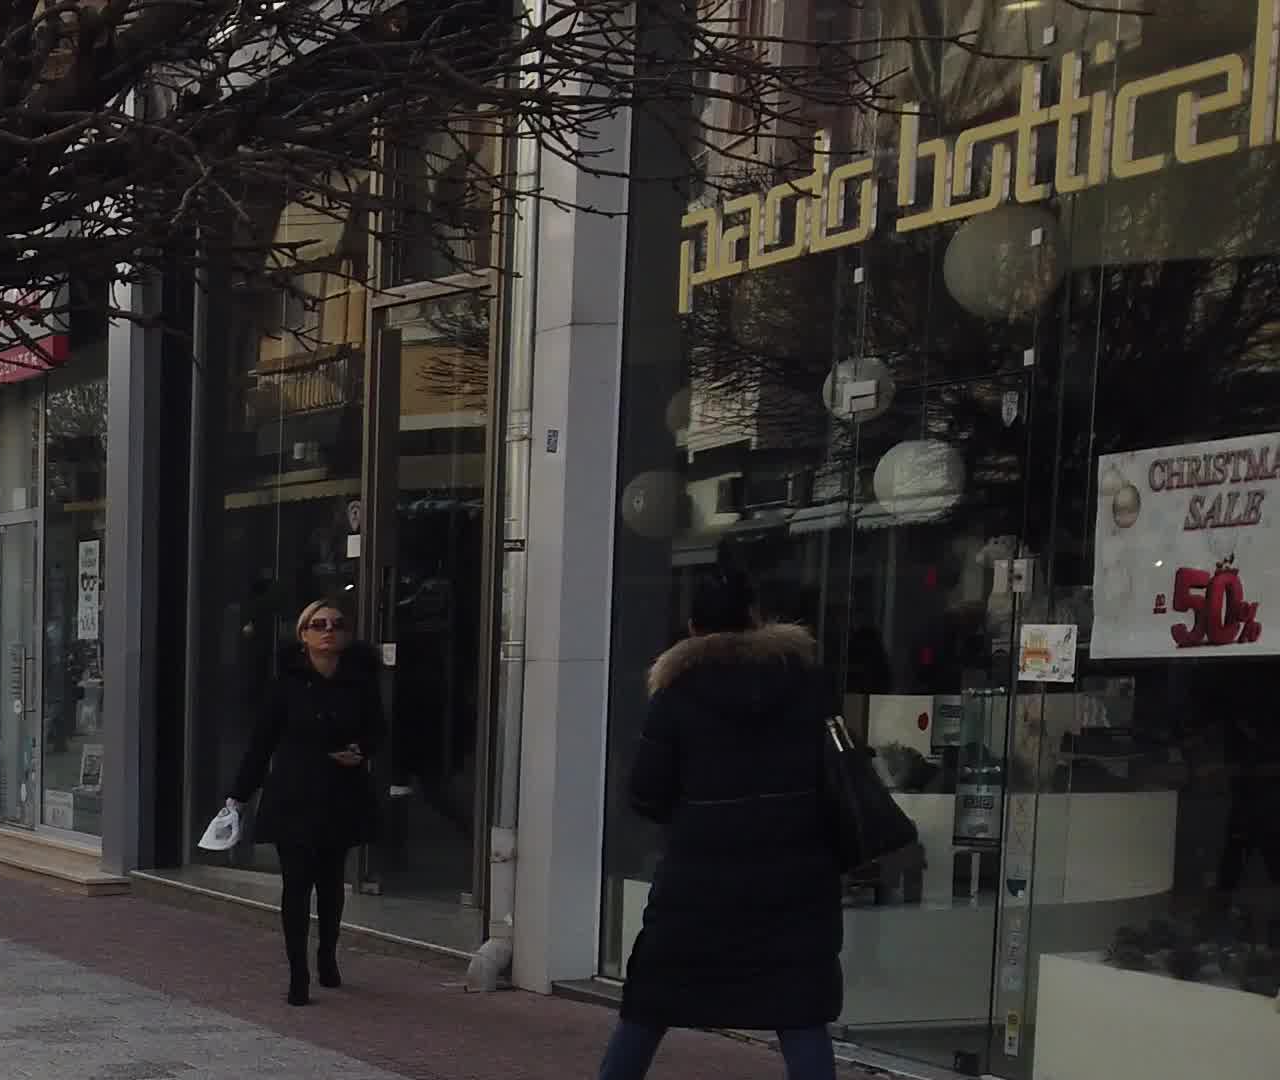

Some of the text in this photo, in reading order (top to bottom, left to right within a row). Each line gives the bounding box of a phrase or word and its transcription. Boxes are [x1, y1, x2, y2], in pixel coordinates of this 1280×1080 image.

[895, 0, 1280, 233] botticel
[1183, 490, 1266, 531] SALE
[1169, 568, 1263, 648] 50%
